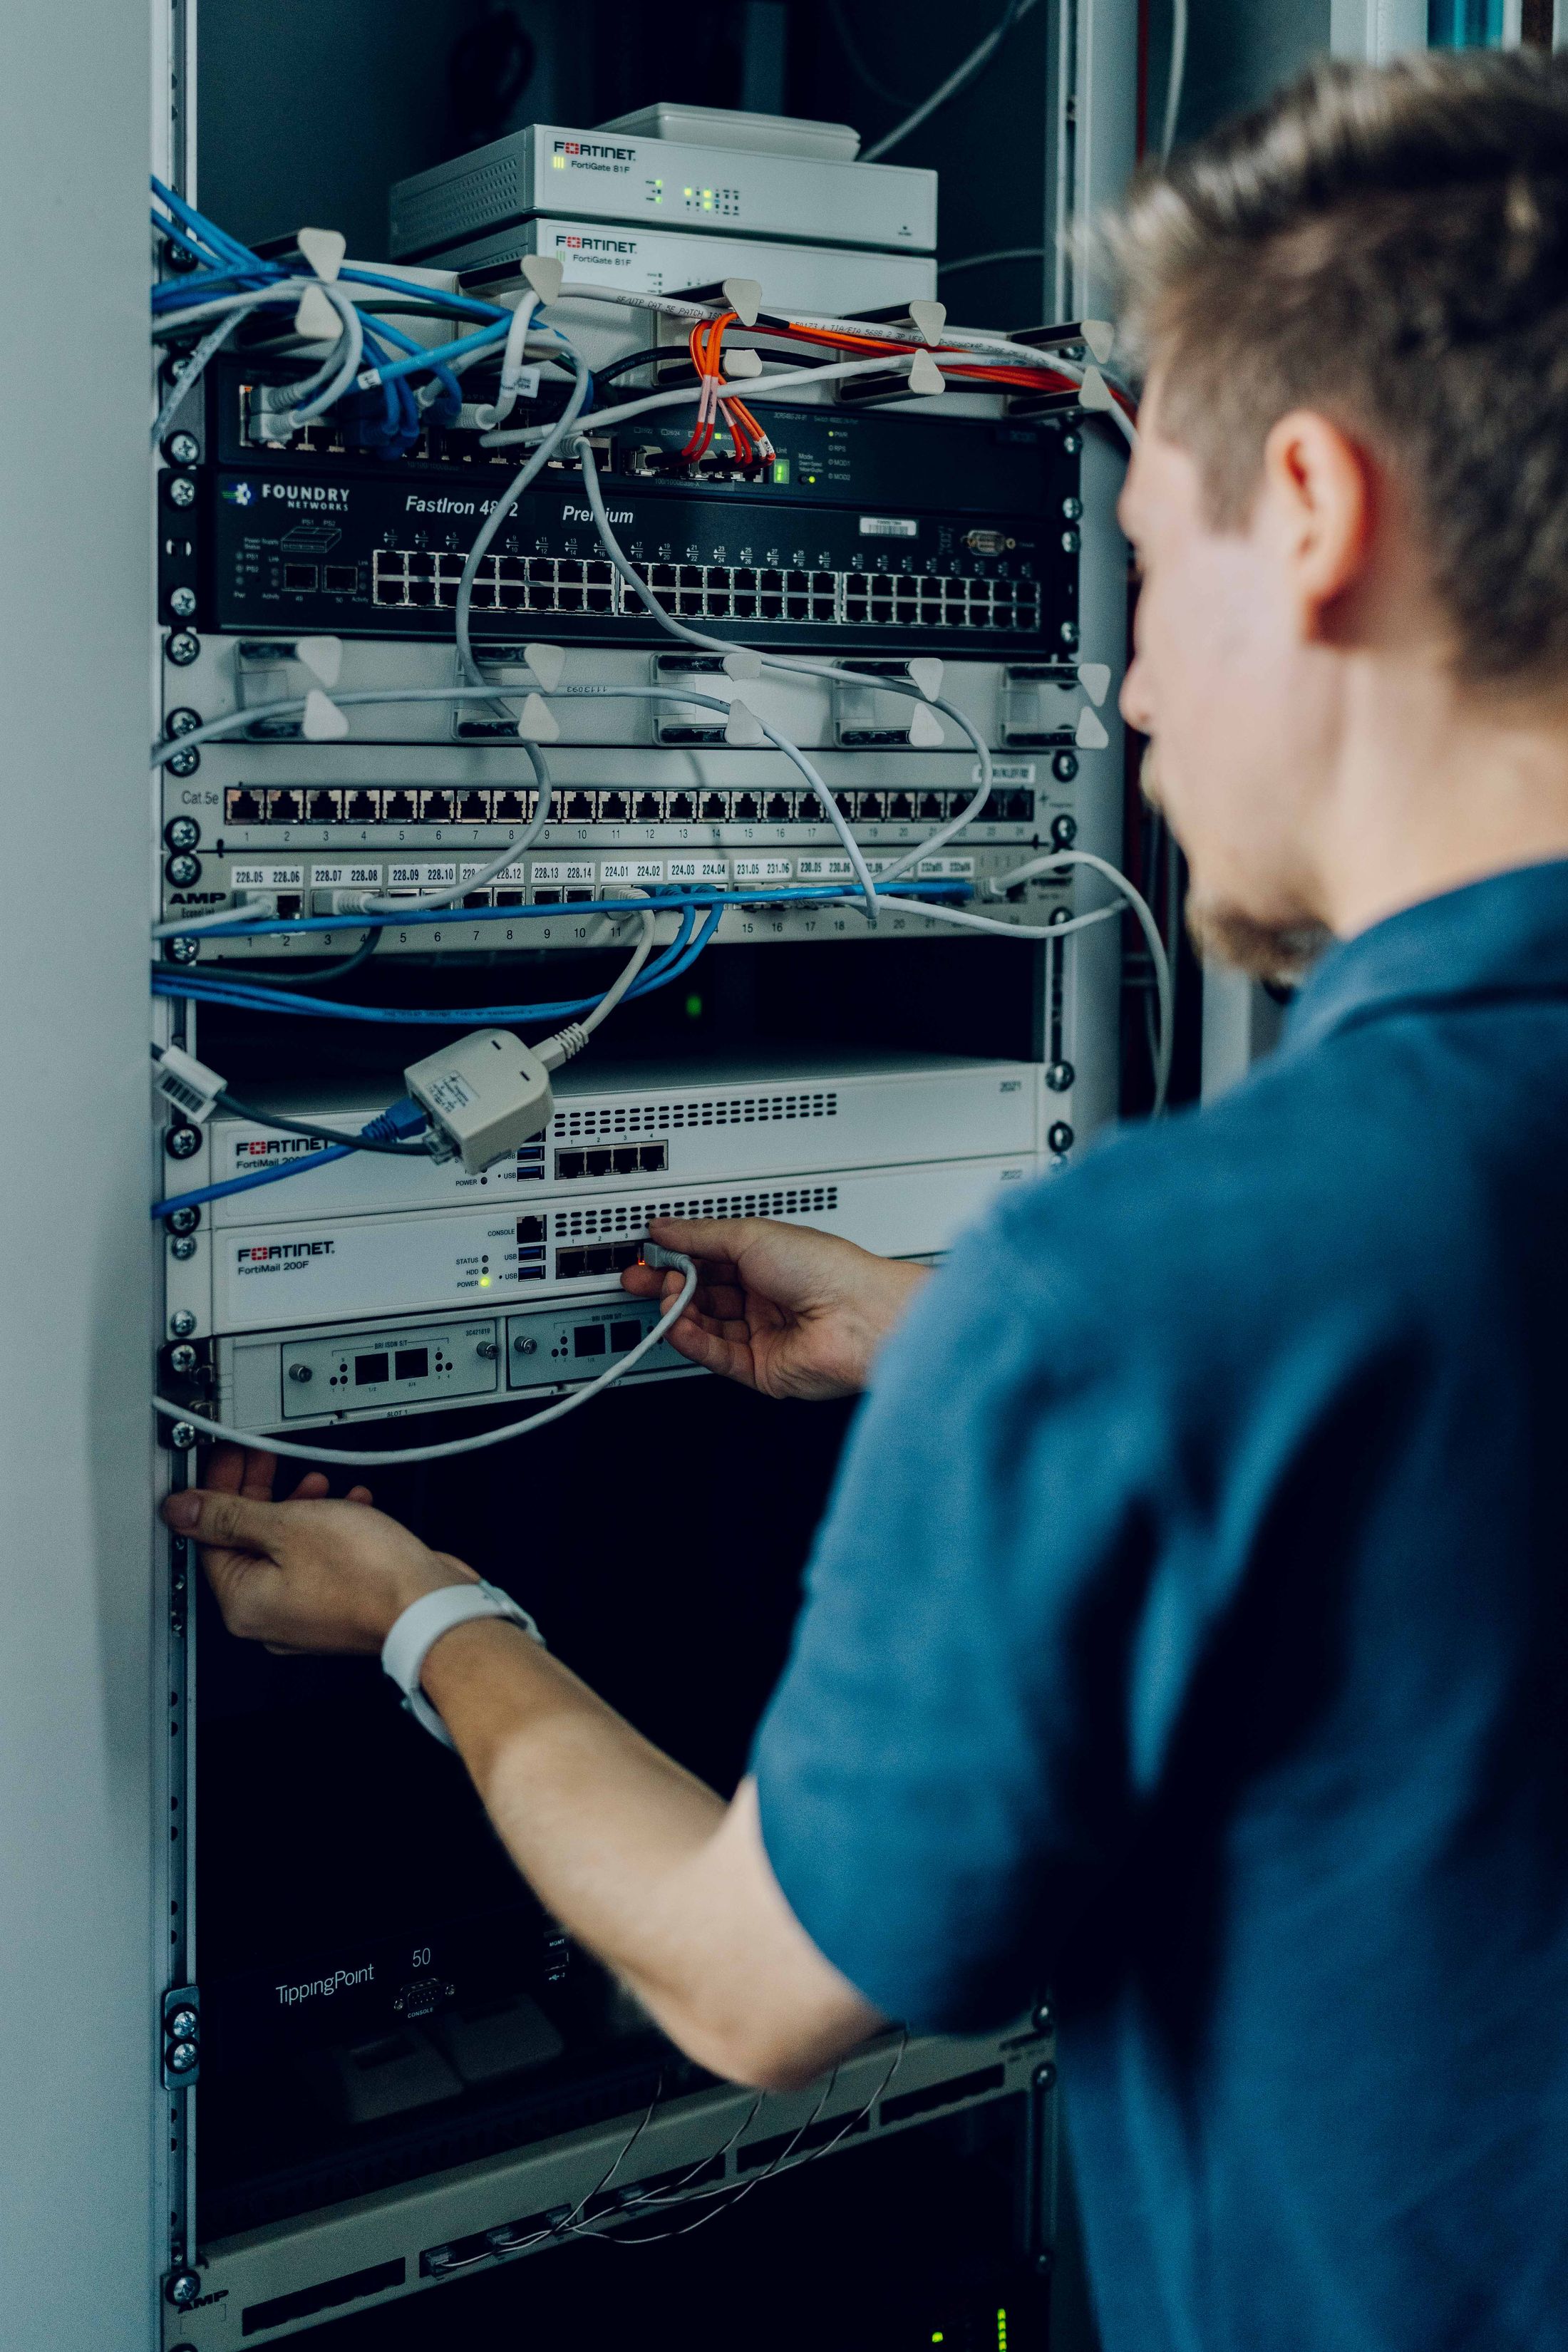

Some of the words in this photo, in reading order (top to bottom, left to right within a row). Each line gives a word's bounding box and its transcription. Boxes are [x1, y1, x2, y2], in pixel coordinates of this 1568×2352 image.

[554, 141, 636, 161] FORTINET
[571, 160, 611, 172] FortiGate
[556, 235, 636, 254] FORTINET
[573, 254, 612, 265] FortiGate
[679, 307, 703, 316] PATCH
[830, 324, 862, 334] TIA/EIA
[262, 484, 351, 502] FOUNDRY
[287, 501, 349, 511] NETWORKS
[406, 496, 475, 515] FastIron
[479, 500, 519, 517] 482
[562, 505, 634, 524] Preium
[182, 790, 220, 805] Cat.5e
[245, 832, 249, 841] 1
[284, 831, 290, 841] 2
[324, 831, 329, 841] 3
[361, 831, 367, 840] 4
[399, 830, 405, 840] 5
[436, 830, 442, 840] 6
[473, 830, 478, 840] 7
[509, 830, 514, 840] 8
[545, 830, 550, 840] 9
[578, 830, 587, 840] 10
[612, 830, 620, 838] 11
[646, 830, 655, 839] 12
[679, 829, 688, 838] 13
[713, 829, 721, 838] 14
[745, 829, 753, 837] 15
[776, 829, 785, 837] 16
[808, 828, 816, 837] 17
[393, 870, 419, 881] 228.09
[428, 869, 453, 880] 228.10
[535, 868, 559, 878] 228.13
[567, 867, 592, 878] 228.14
[605, 866, 629, 877] 224.01
[637, 866, 660, 877] 224.02
[671, 865, 695, 875] 224.03
[703, 865, 726, 875] 224.04
[737, 864, 760, 875] 231.05
[237, 872, 264, 883] 228.05
[273, 871, 300, 882] 228.06
[316, 870, 342, 882] 228.07
[351, 870, 378, 881] 228.08
[170, 892, 226, 904] AMP
[248, 937, 252, 947] 1
[283, 936, 290, 947] 2
[324, 934, 331, 945] 3
[400, 932, 407, 943] 5
[434, 932, 441, 942] 6
[473, 931, 480, 940] 7
[506, 930, 513, 939] 8
[544, 929, 550, 939] 9
[574, 928, 586, 937] 10
[611, 927, 621, 937] 11
[743, 924, 753, 933] 15
[773, 923, 783, 932] 16
[805, 922, 816, 932] 17
[237, 1158, 279, 1169] FortiMail
[488, 1229, 515, 1237] CONSOLE
[238, 1240, 334, 1262] FORTINET
[238, 1264, 281, 1276] FortiMail
[283, 1260, 309, 1271] 200F
[275, 1963, 375, 2006] TippingPoint
[413, 1948, 431, 1968] 50
[407, 2006, 434, 2018] CONSOLE
[178, 2289, 229, 2314] AMP
